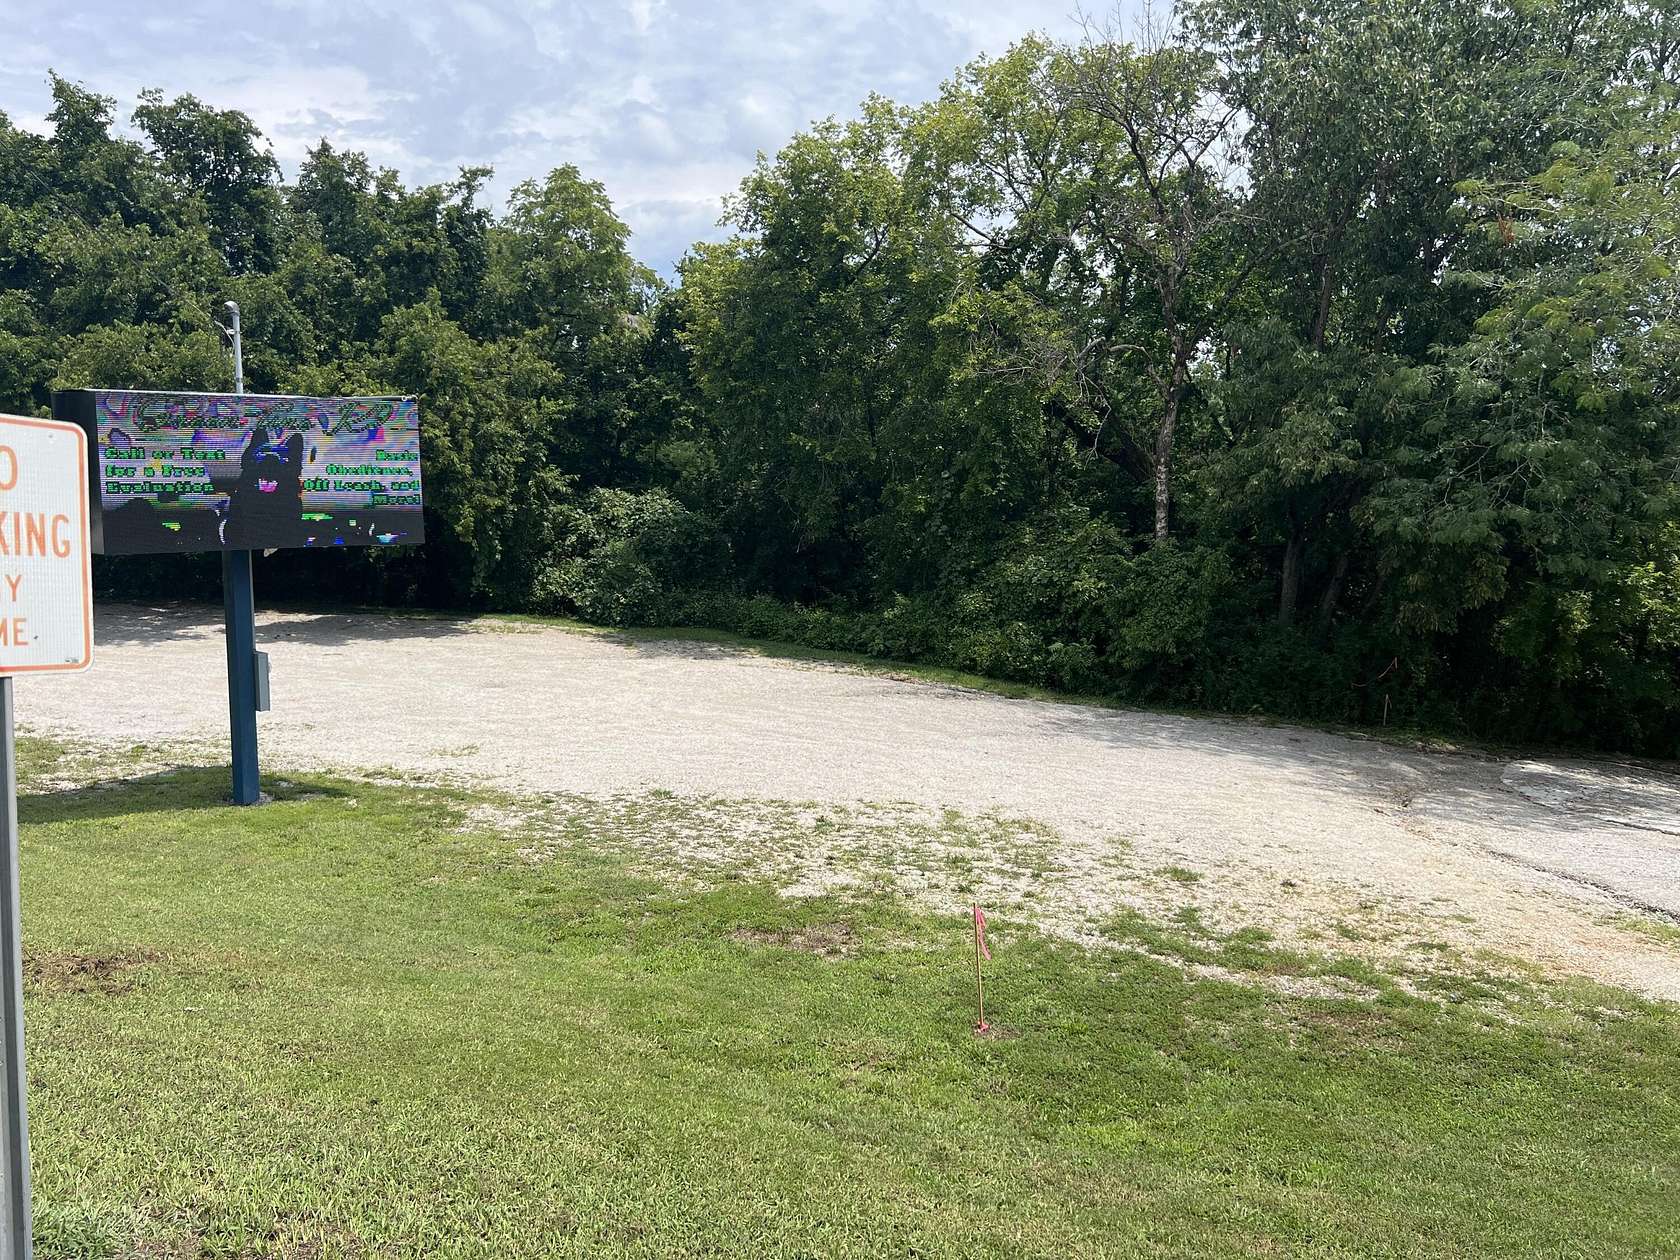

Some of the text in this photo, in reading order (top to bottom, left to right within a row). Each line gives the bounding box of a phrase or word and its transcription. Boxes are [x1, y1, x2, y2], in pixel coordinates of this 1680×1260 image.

[105, 446, 225, 460] Call or Text
[106, 464, 205, 477] for a Free
[106, 481, 214, 494] Evaluation
[304, 478, 329, 491] Off
[391, 479, 420, 491] and
